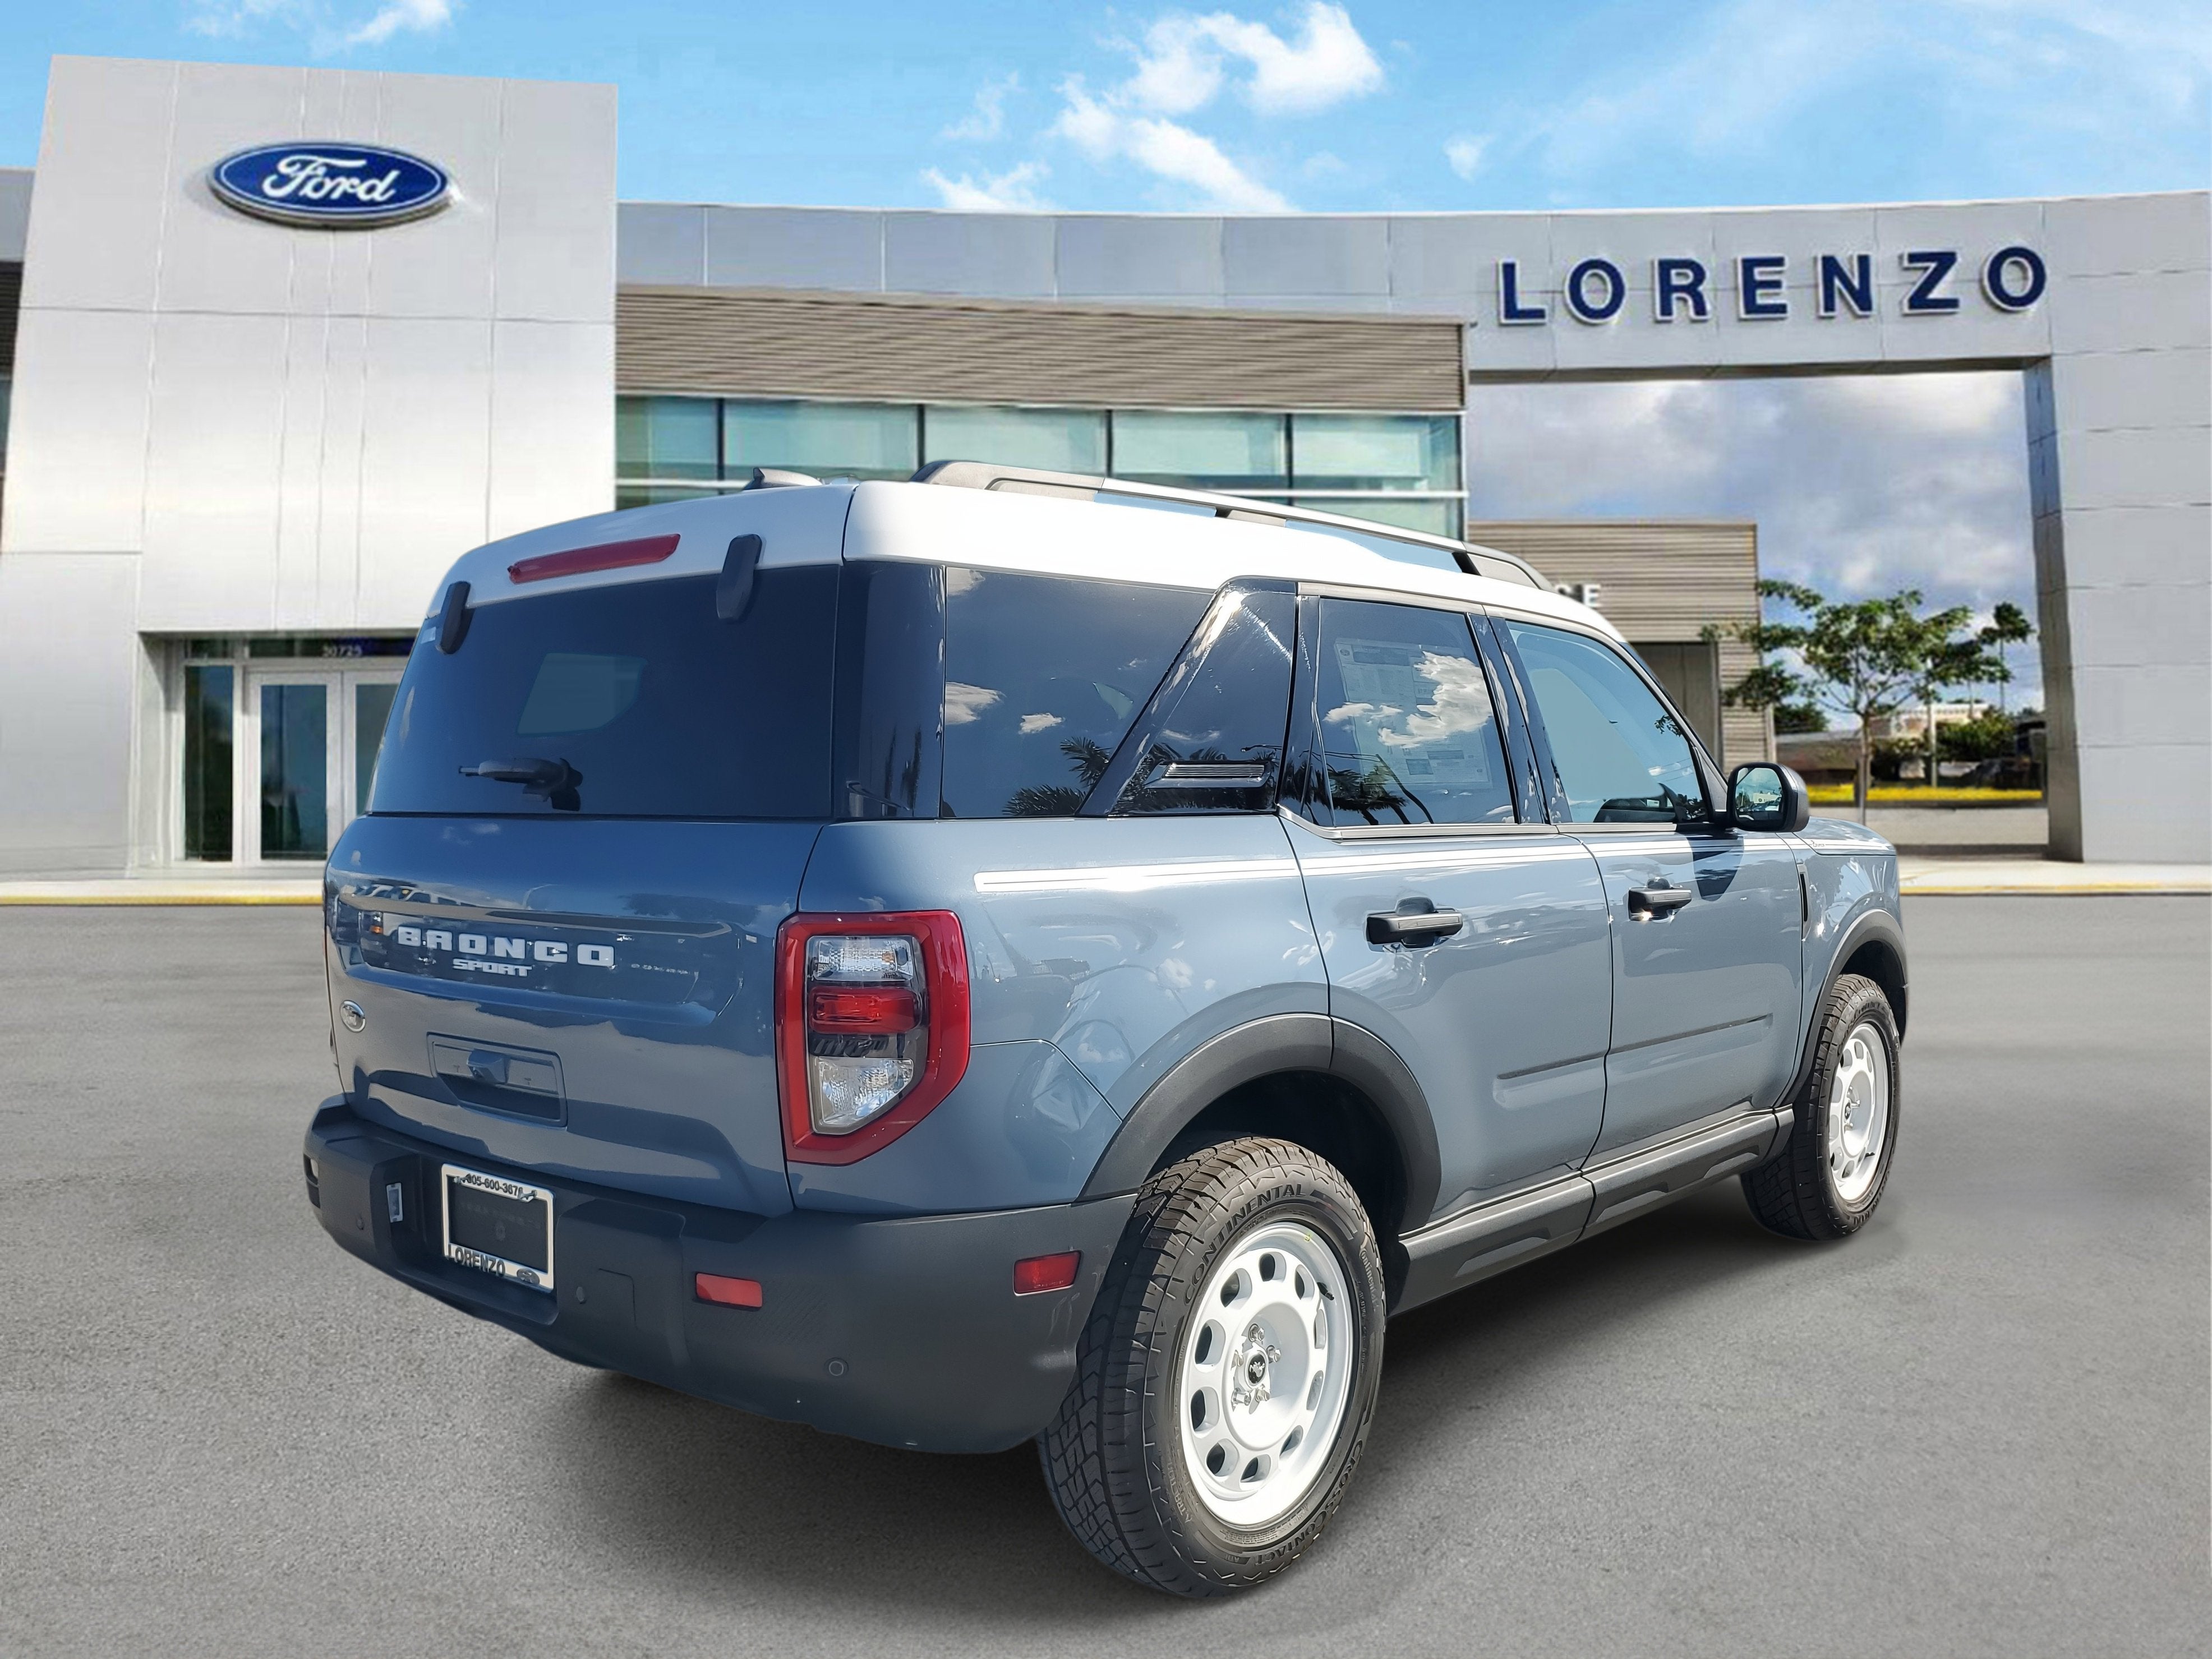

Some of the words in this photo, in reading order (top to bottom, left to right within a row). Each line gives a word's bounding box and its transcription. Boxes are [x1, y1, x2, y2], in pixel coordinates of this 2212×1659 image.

[262, 154, 401, 201] Ford
[1497, 246, 2047, 326] LORENZO
[398, 926, 615, 966] BRONCO
[453, 958, 533, 977] SPORT
[448, 1243, 505, 1278] LORENZO
[1184, 1183, 1306, 1306] CONTINENTAL
